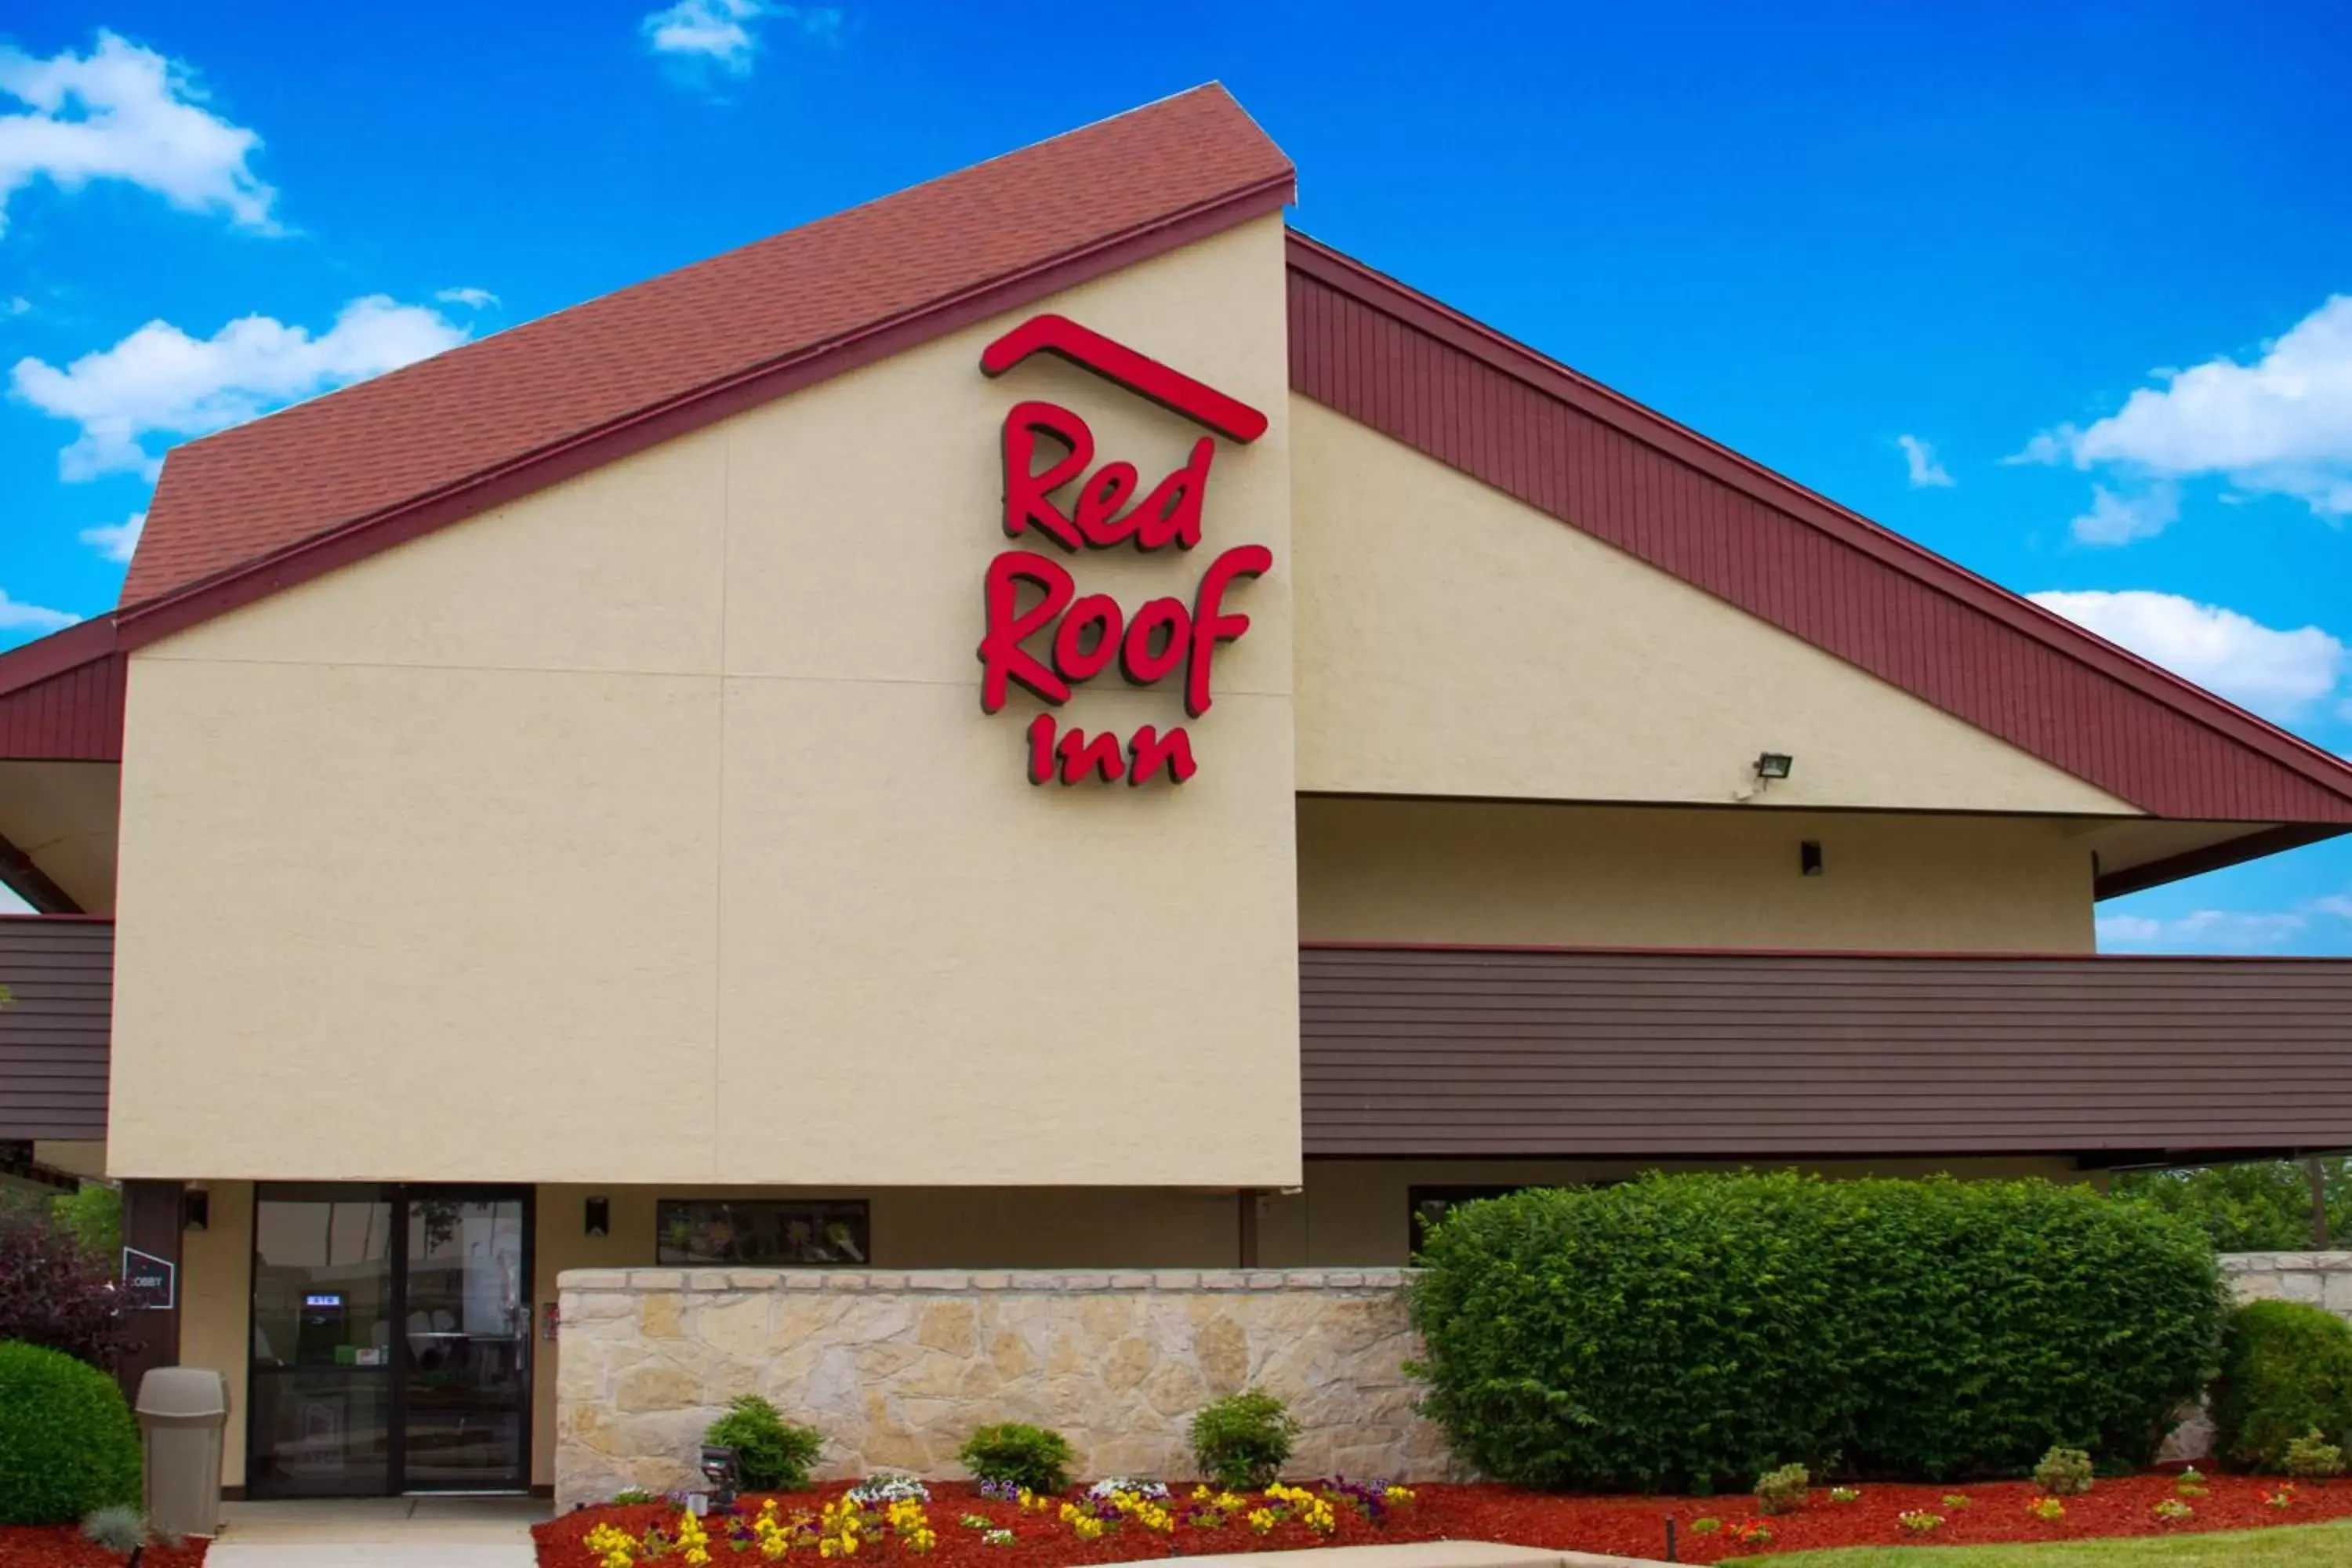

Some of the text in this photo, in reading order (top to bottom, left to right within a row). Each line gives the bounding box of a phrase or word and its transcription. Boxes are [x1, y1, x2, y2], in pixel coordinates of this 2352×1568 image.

[1003, 401, 1215, 550] Red
[978, 544, 1272, 717] Roof
[1028, 713, 1197, 786] Inn
[134, 1276, 163, 1287] OBBY
